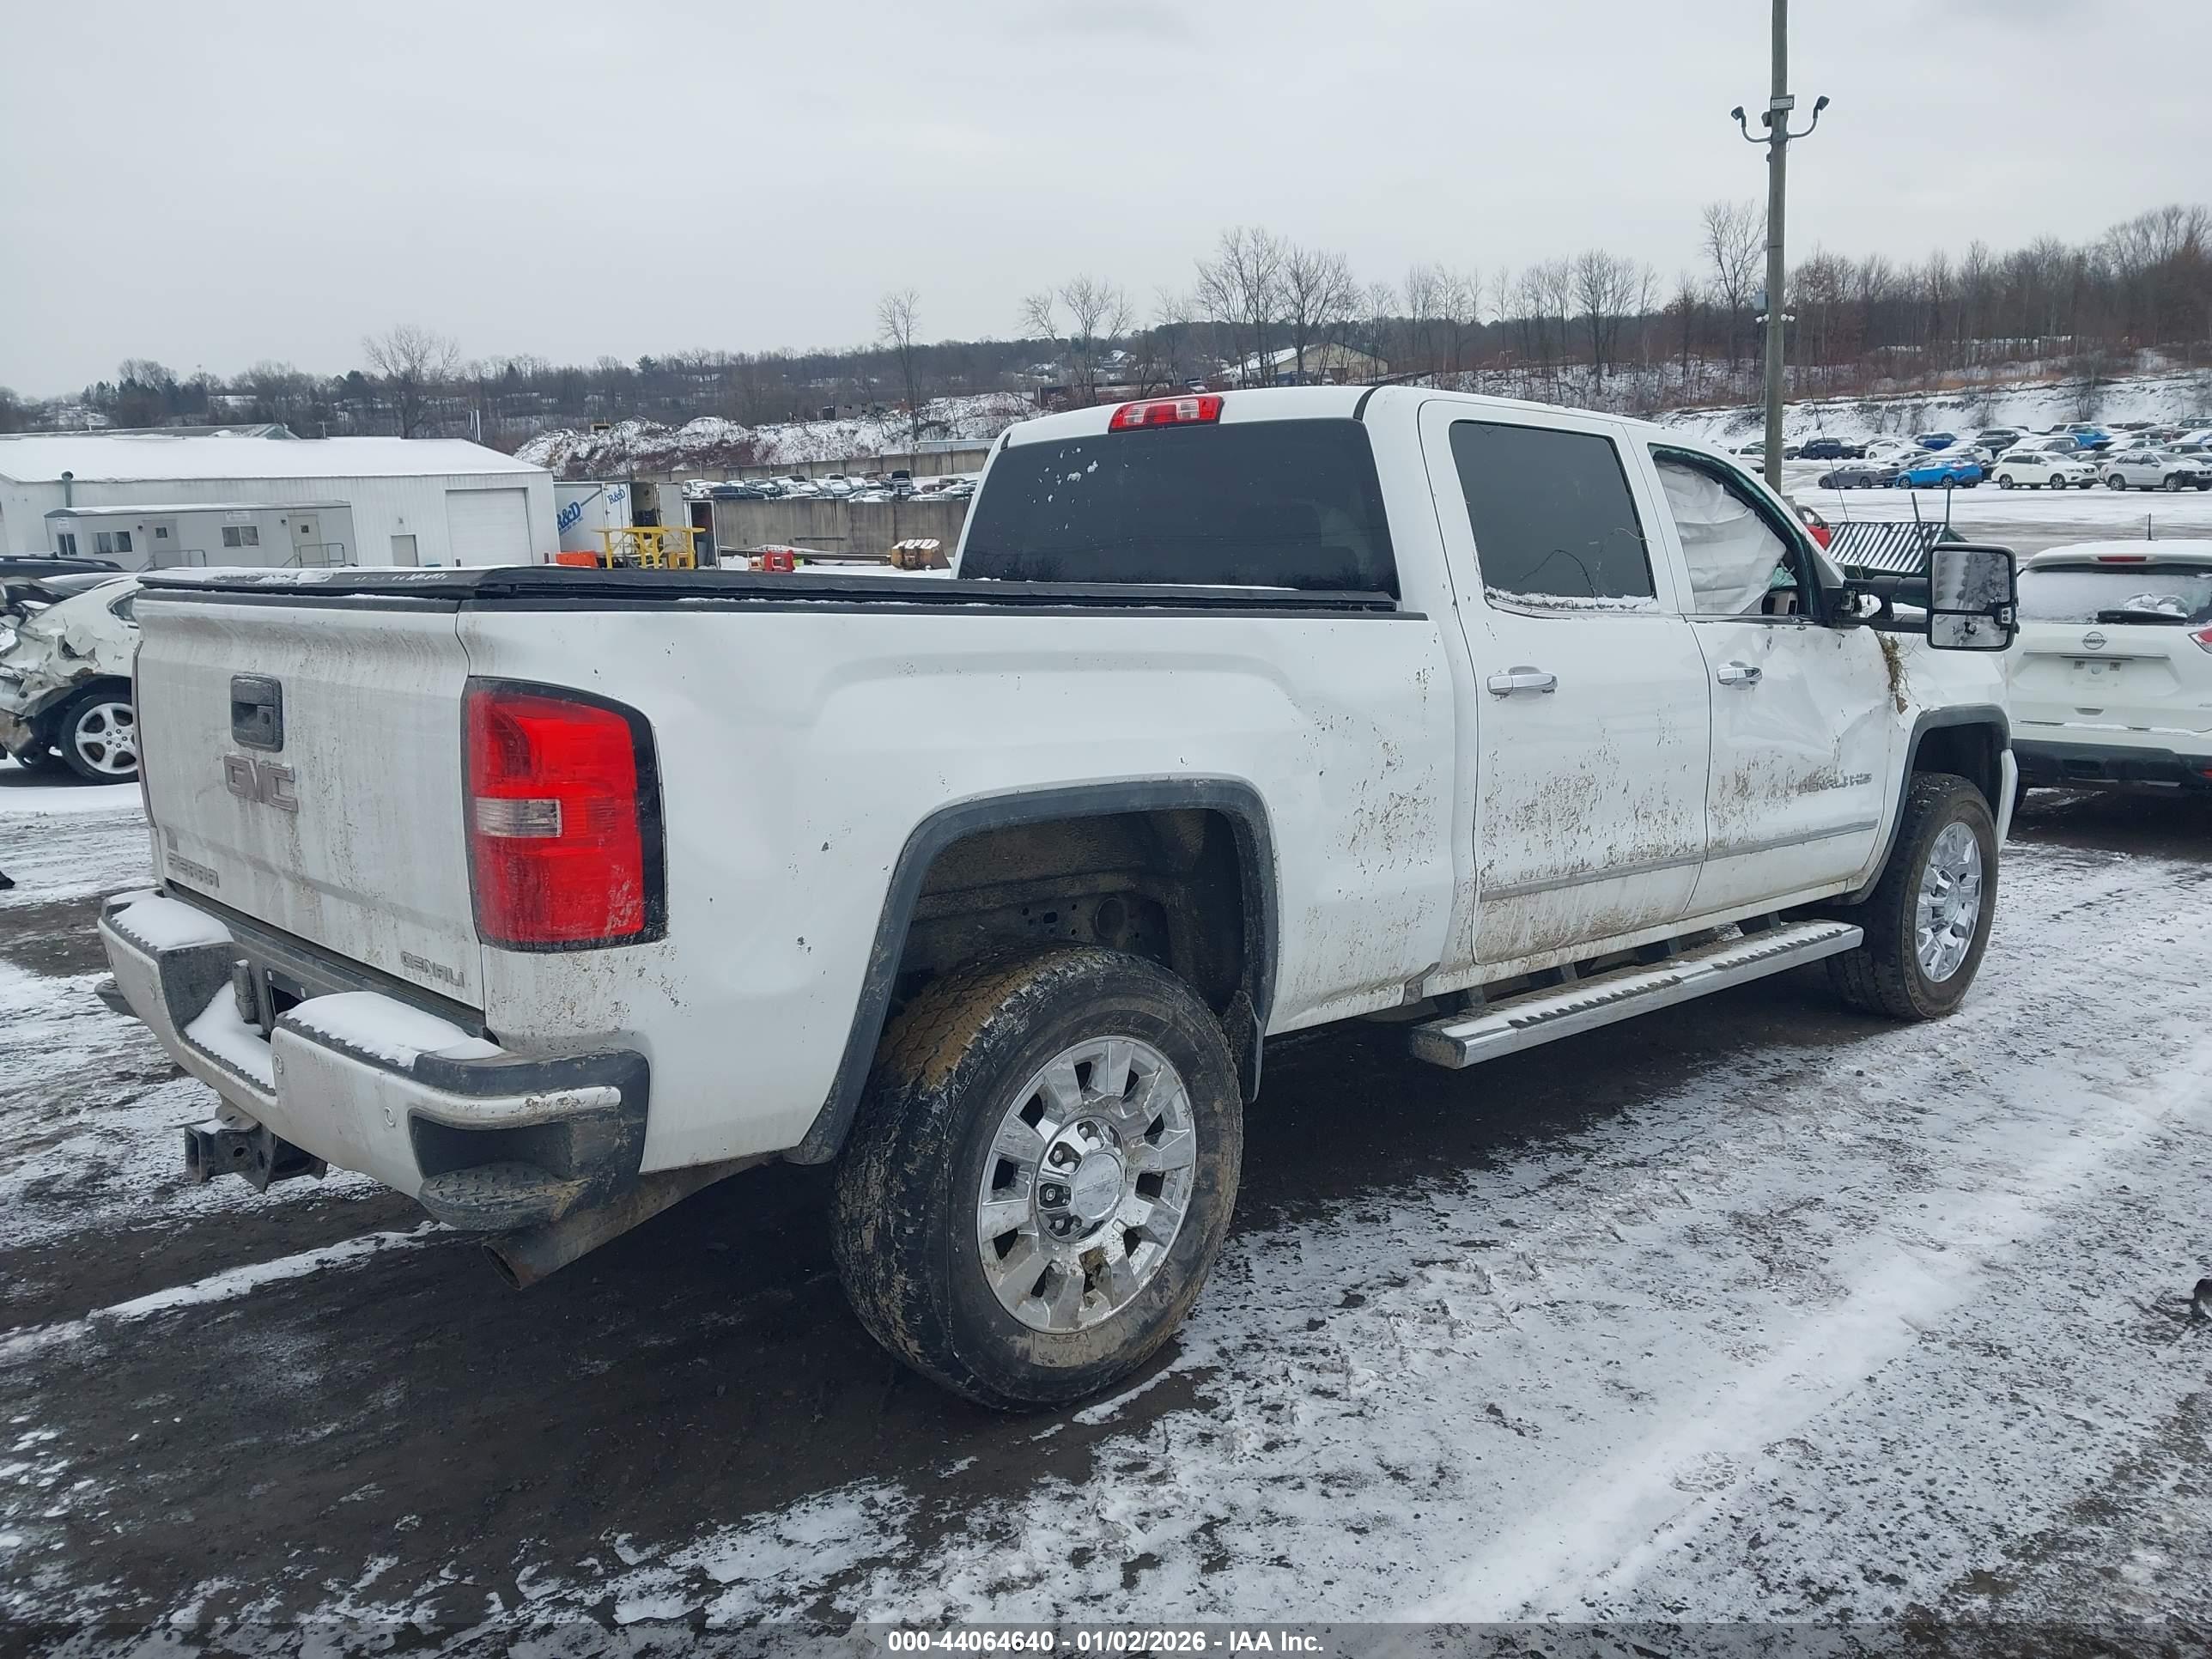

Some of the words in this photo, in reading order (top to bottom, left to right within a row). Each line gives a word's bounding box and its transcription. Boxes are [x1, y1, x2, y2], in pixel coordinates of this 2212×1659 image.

[607, 489, 626, 504] R&D
[223, 755, 299, 813] GMC
[167, 852, 220, 888] SIERRA
[400, 951, 465, 989] DENALI
